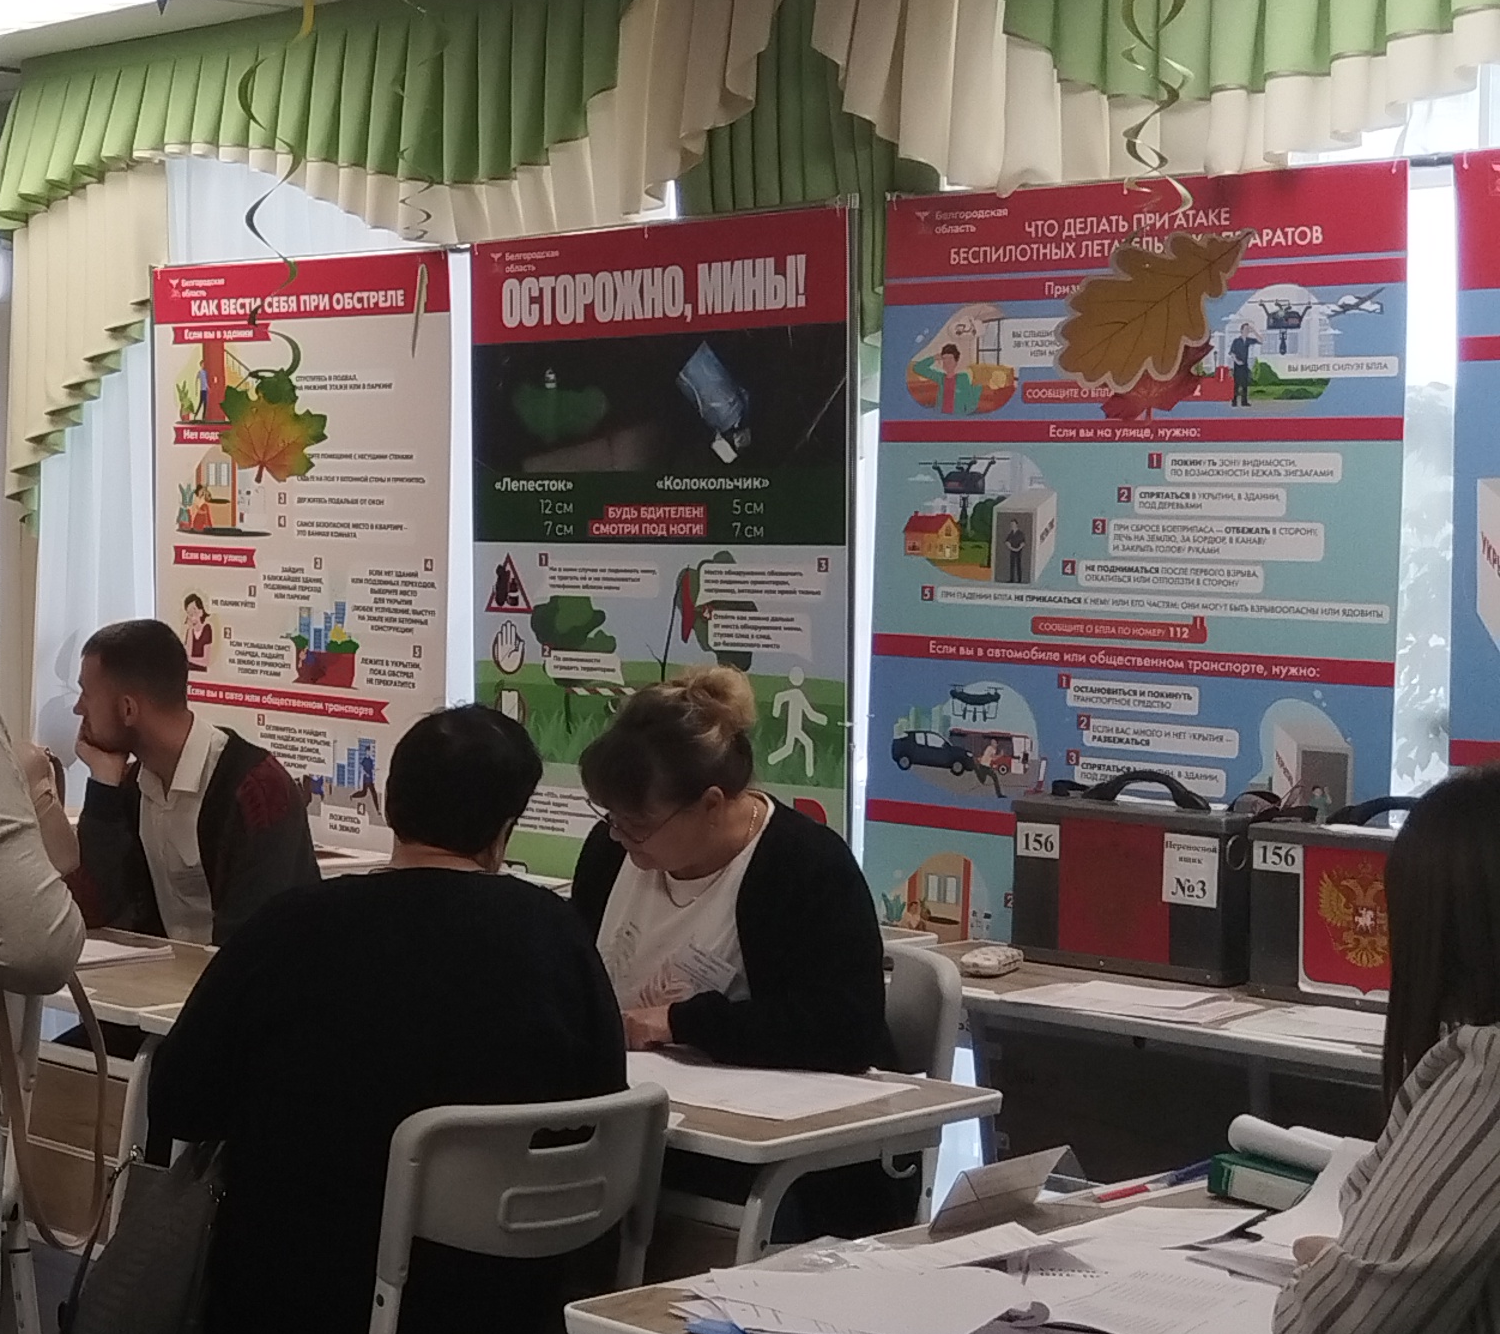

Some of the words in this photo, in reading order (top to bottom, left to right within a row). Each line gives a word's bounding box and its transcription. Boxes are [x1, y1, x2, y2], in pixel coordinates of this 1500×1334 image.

[935, 208, 1008, 221] Белгородская
[935, 224, 976, 234] область
[1025, 219, 1059, 239] ЧТО
[1062, 215, 1129, 239] ДЕЛАТЬ
[1133, 212, 1170, 231] ПРИ
[1174, 207, 1230, 228] АТАКЕ
[950, 242, 1076, 265] БЕСПИЛОТНЫХ
[505, 264, 536, 273] область
[502, 265, 692, 328] ОСТОРОЖНО,
[697, 254, 806, 315] МИНЫ!
[191, 298, 218, 317] КАК
[221, 296, 261, 315] ВЕСТИ
[264, 295, 297, 313] СЕБЯ
[300, 293, 329, 311] ПРИ
[332, 289, 404, 310] ОБСТРЕЛЕ
[1049, 425, 1076, 438] Если
[1079, 427, 1094, 438] вы
[1097, 427, 1111, 438] на
[1114, 427, 1153, 440] улице,
[1157, 427, 1201, 440] нужно:
[494, 477, 573, 493] «Лепесток»
[656, 475, 770, 490] «Колокольчик»
[539, 499, 552, 514] 12
[554, 503, 573, 514] см
[608, 506, 638, 520] БУДЬ
[640, 506, 704, 520] БДИТЕЛЕН!
[732, 499, 741, 514] 5
[744, 503, 764, 514] см
[544, 521, 553, 536] 7
[555, 525, 574, 536] см
[592, 523, 639, 535] СМОТРИ
[642, 523, 666, 536] ПОД
[669, 523, 704, 535] НОГИ!
[732, 522, 742, 538] 7
[744, 526, 764, 538] см
[1169, 627, 1189, 639] 112
[929, 640, 956, 655] Если
[959, 646, 974, 656] вы
[977, 647, 984, 656] в
[986, 646, 1060, 661] автомобиле
[1063, 653, 1086, 663] или
[1089, 651, 1184, 669] общественном
[1187, 660, 1268, 676] транспорте,
[1272, 664, 1320, 679] нужно:
[1022, 832, 1054, 853] 156
[1165, 840, 1217, 854] Переносной
[1178, 854, 1203, 866] ящик
[1259, 845, 1296, 867] 156
[1171, 877, 1206, 899] №3
